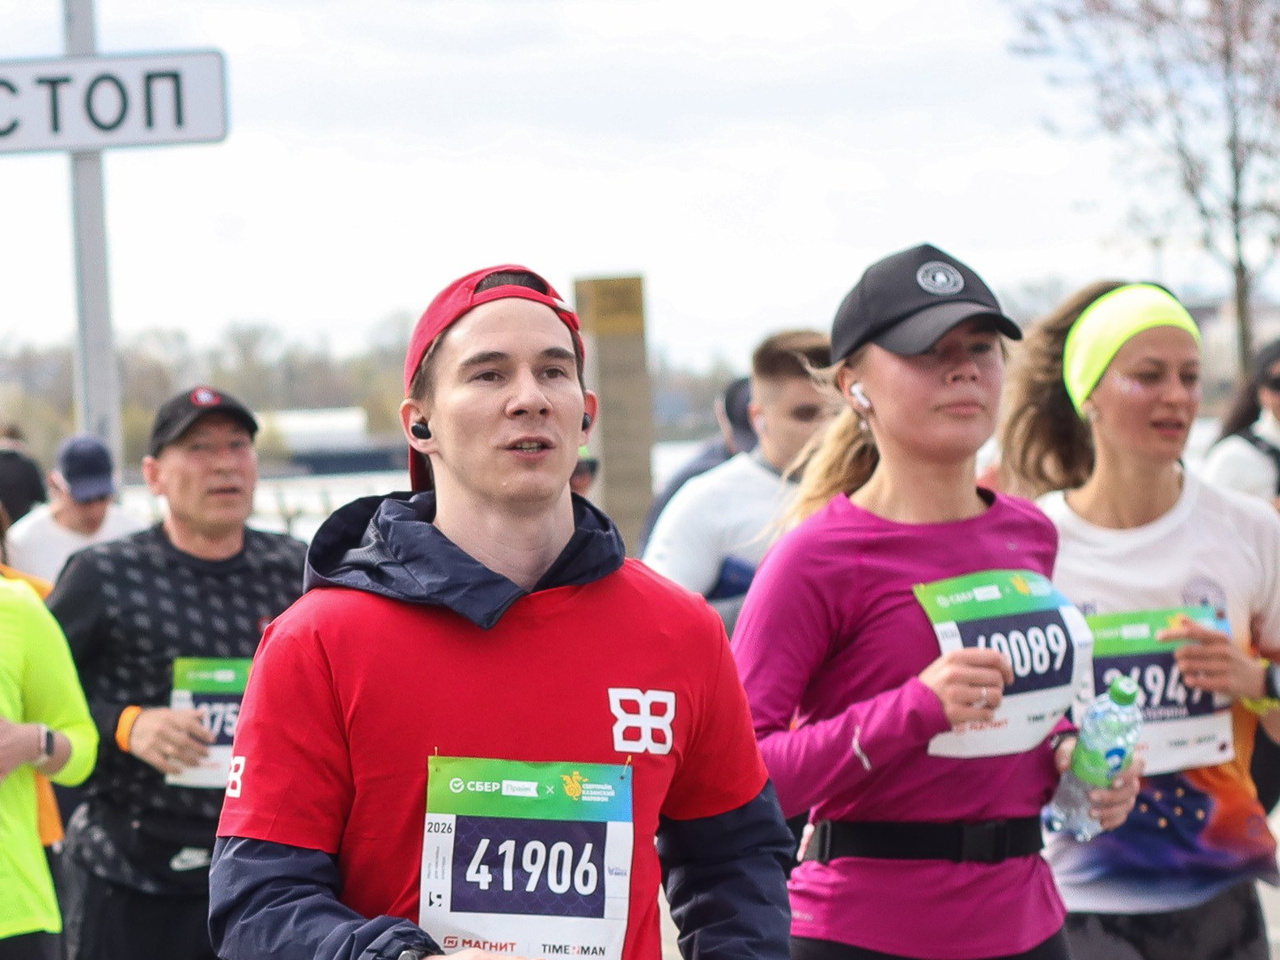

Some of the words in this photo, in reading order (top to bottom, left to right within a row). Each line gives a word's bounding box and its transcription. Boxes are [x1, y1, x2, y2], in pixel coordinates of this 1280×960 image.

[466, 780, 501, 792] СБЕР
[427, 821, 453, 834] 2026
[465, 838, 598, 896] 41906
[461, 938, 517, 953] МАГНИТ
